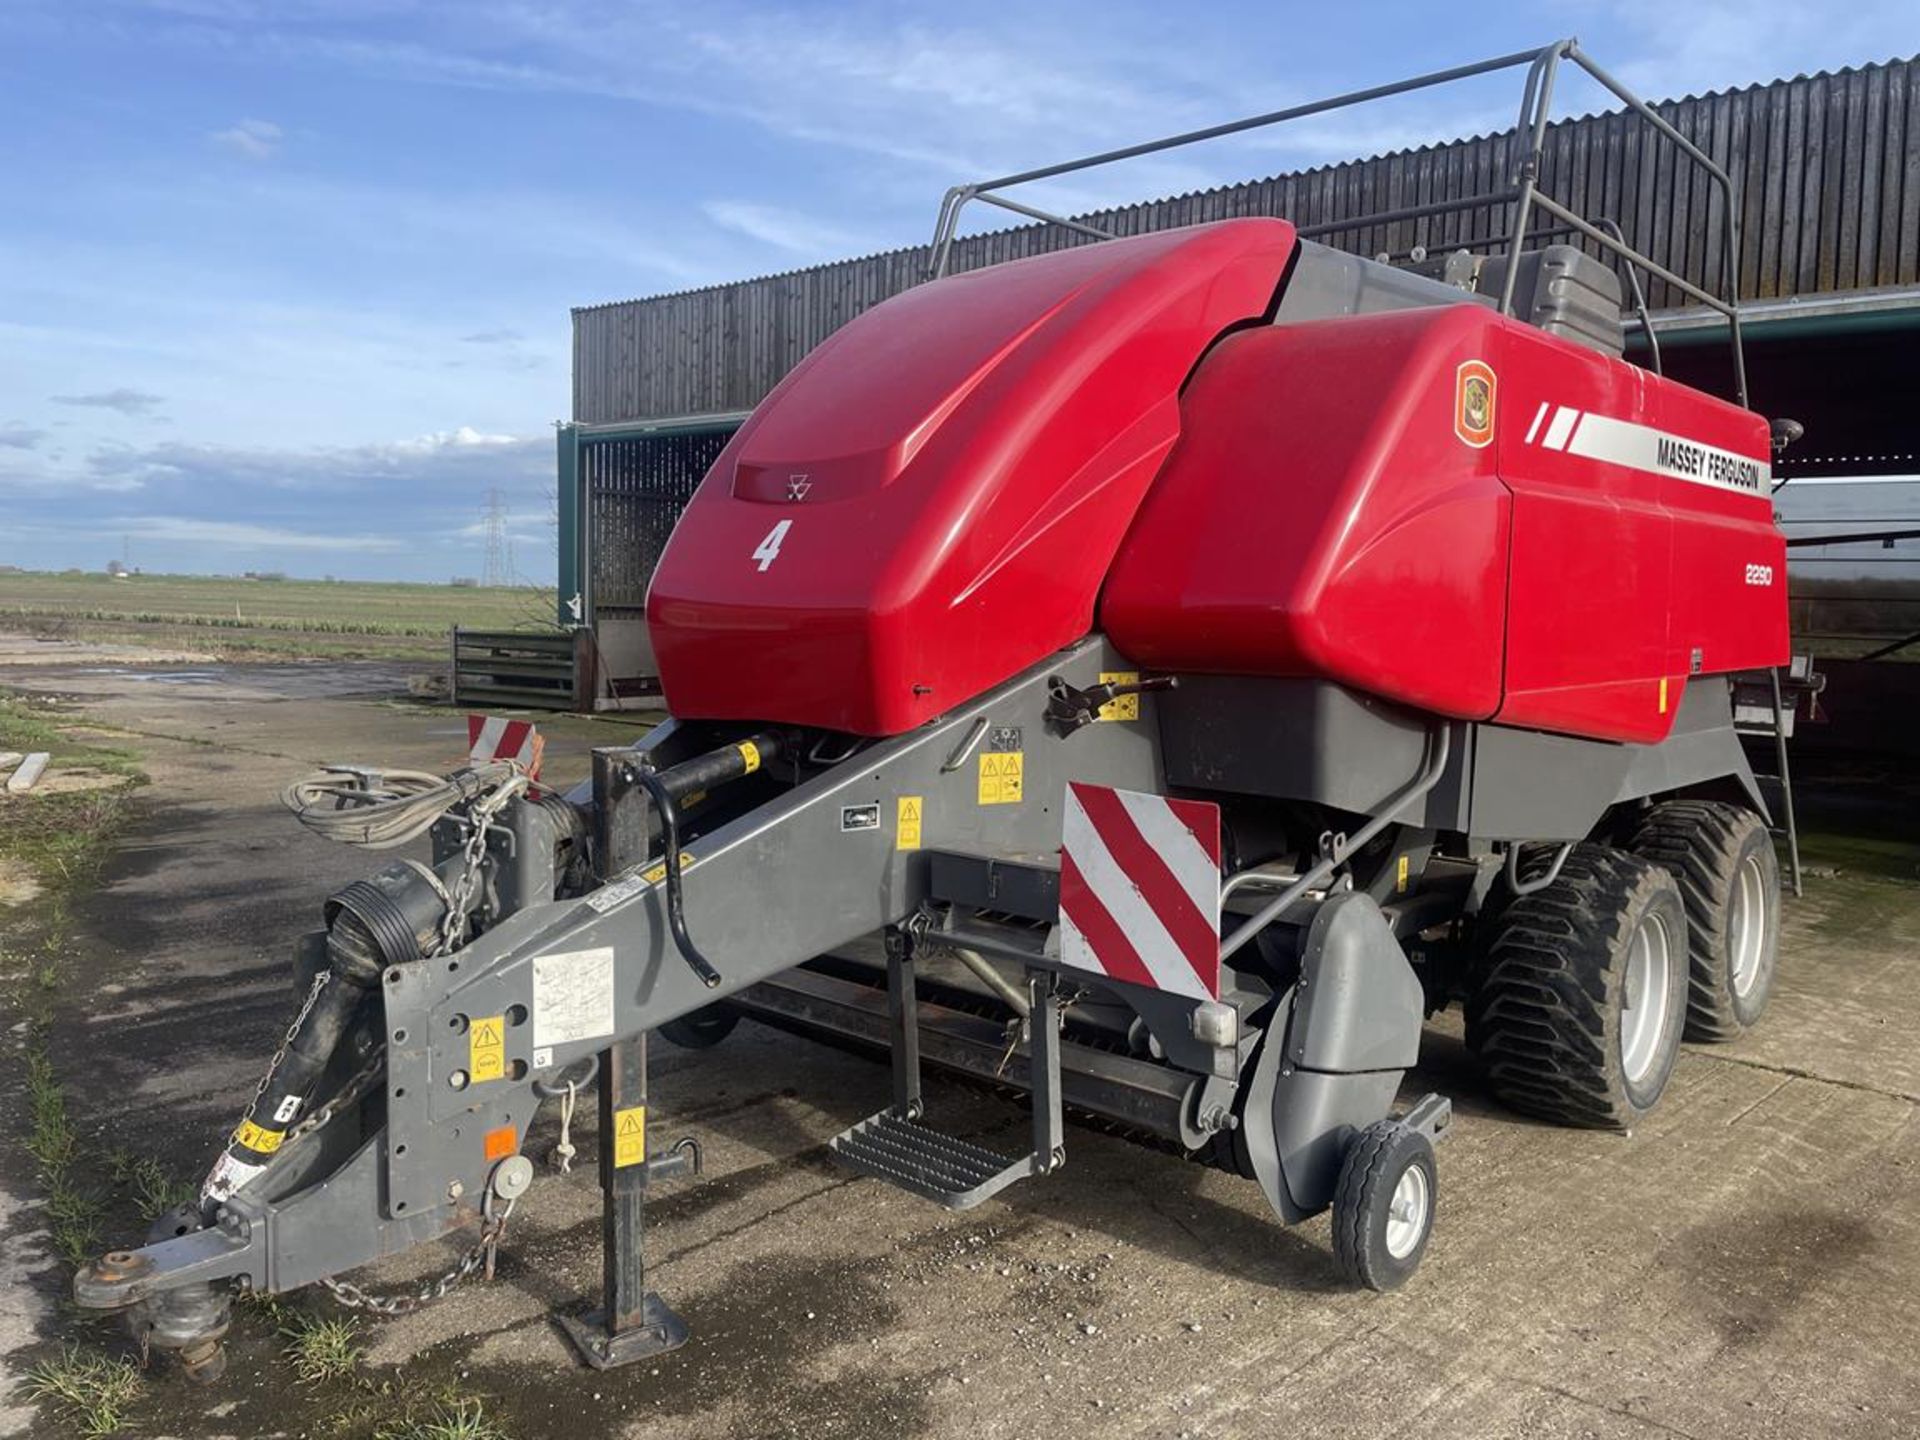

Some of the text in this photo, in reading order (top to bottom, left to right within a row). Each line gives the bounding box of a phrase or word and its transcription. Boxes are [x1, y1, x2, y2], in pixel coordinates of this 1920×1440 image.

[1657, 438, 1758, 489] MASSEY FERGUSON
[752, 520, 793, 571] 4
[1746, 564, 1772, 585] 2290
